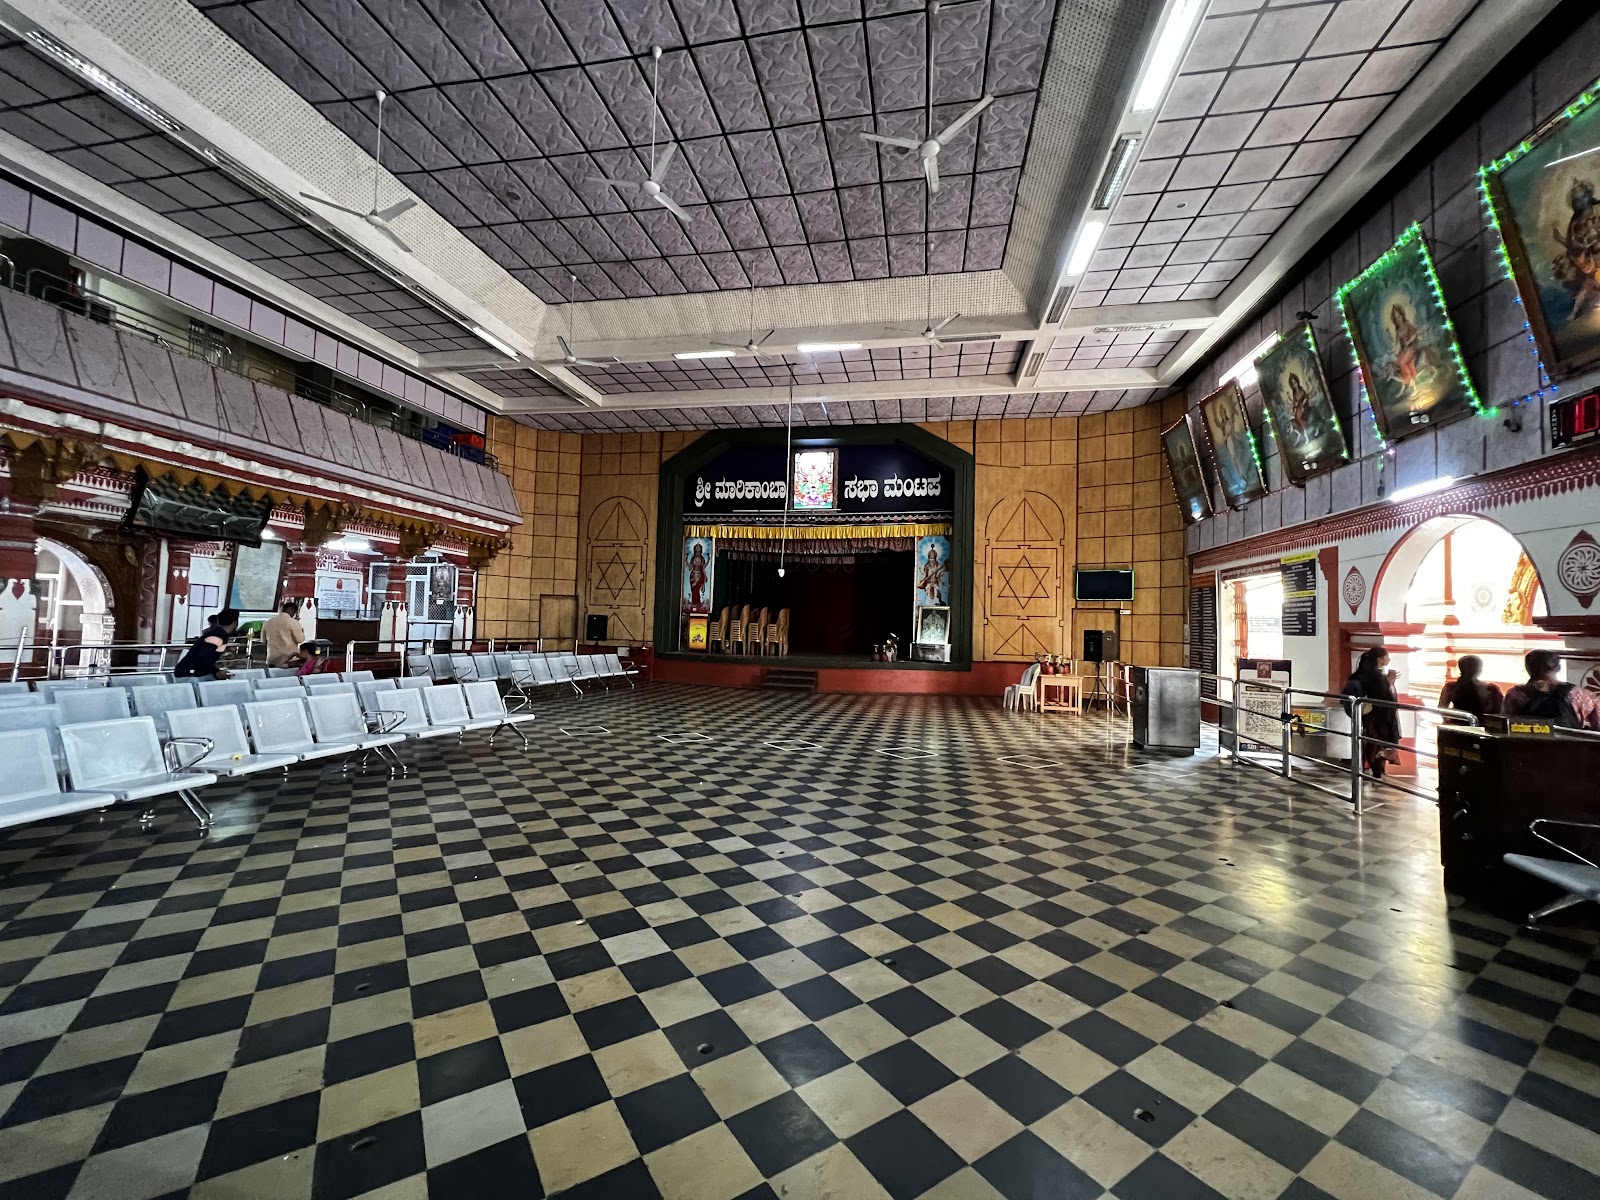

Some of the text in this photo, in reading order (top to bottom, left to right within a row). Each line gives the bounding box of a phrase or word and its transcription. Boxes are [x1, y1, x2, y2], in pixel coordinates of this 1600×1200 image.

[694, 472, 941, 508] ಶ್ರೀ ಮಾರಿಕಾಂಬಾ ಸಭಾ ಮಂಟಪ
